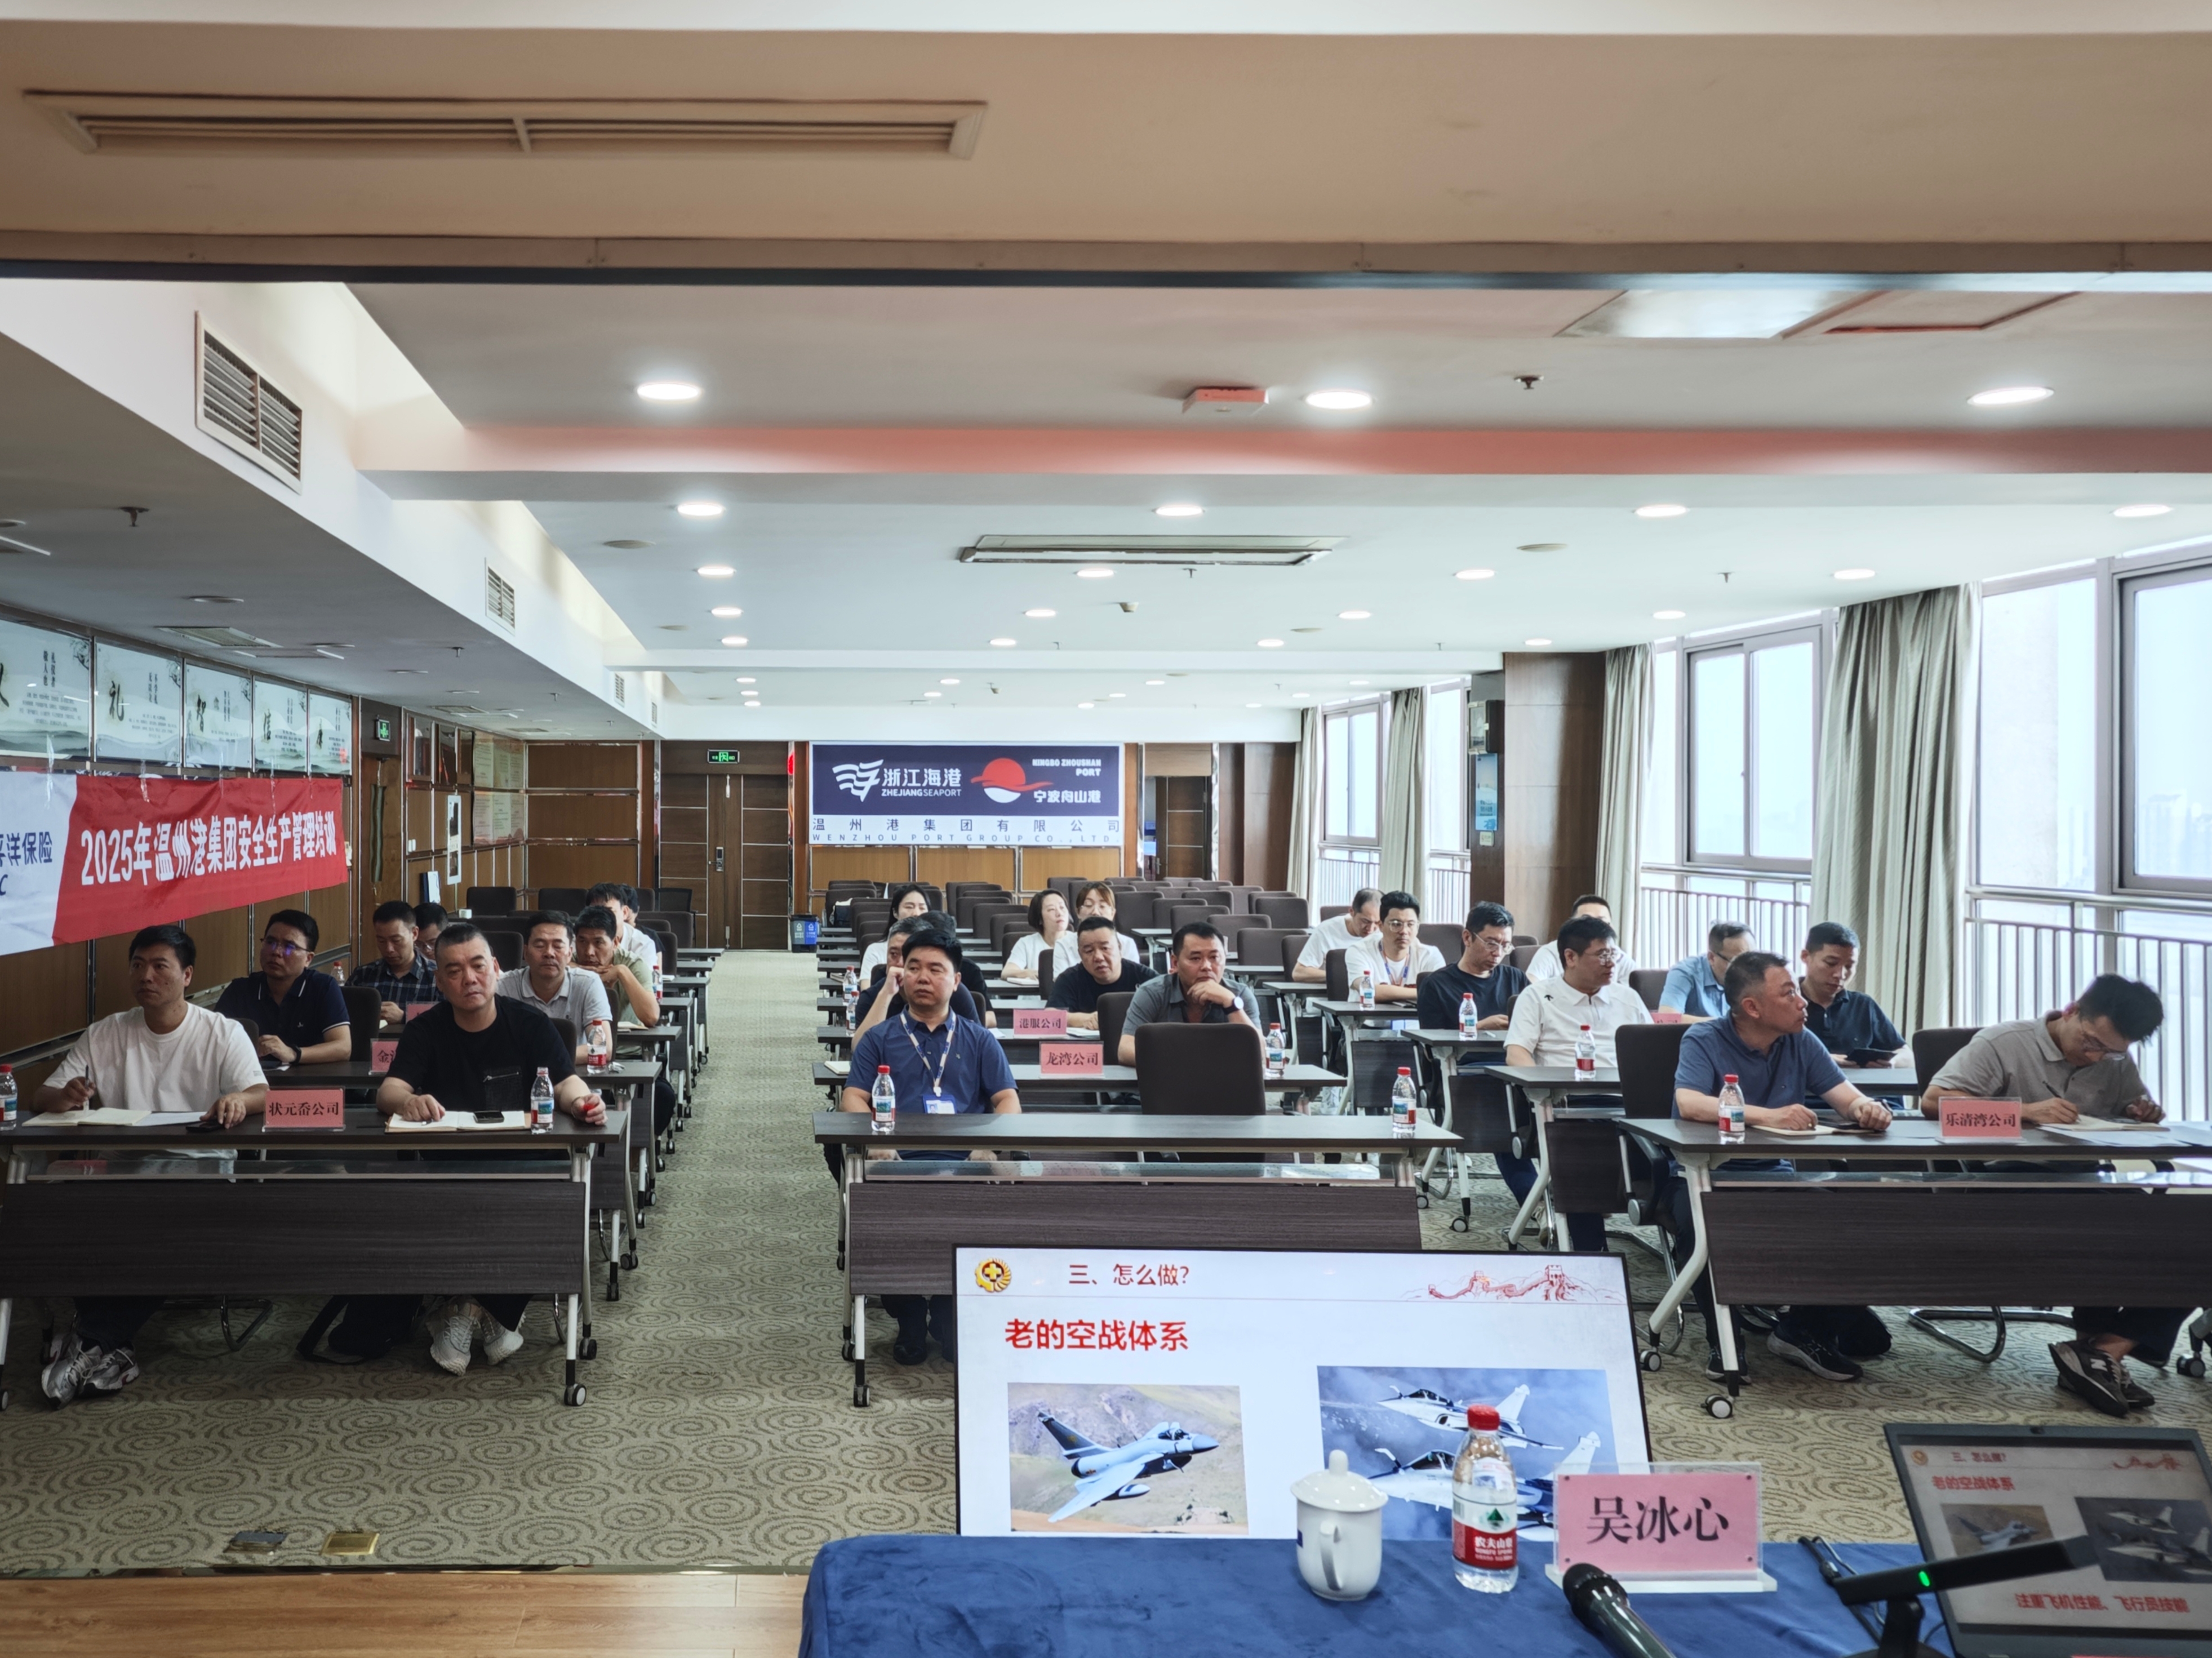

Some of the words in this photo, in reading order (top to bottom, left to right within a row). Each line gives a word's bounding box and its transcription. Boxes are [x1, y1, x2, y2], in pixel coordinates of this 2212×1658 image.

[882, 768, 961, 786] 浙江海港
[1076, 768, 1101, 776] PORT
[1034, 790, 1101, 803] 宁波舟山港
[812, 818, 1119, 832] 温州港集团有限公司
[81, 811, 336, 886] 2025年温州港集团安全生产管理培训
[1020, 1018, 1061, 1029] 港服公司
[1046, 1052, 1098, 1066] 龙湾公司
[269, 1101, 339, 1117] 状元岙公司
[1946, 1113, 2016, 1127] 乐清湾公司
[1005, 1318, 1189, 1352] 老的空战体系
[1931, 1475, 2016, 1491] 老的空战体系
[1587, 1495, 1729, 1544] 吴冰心
